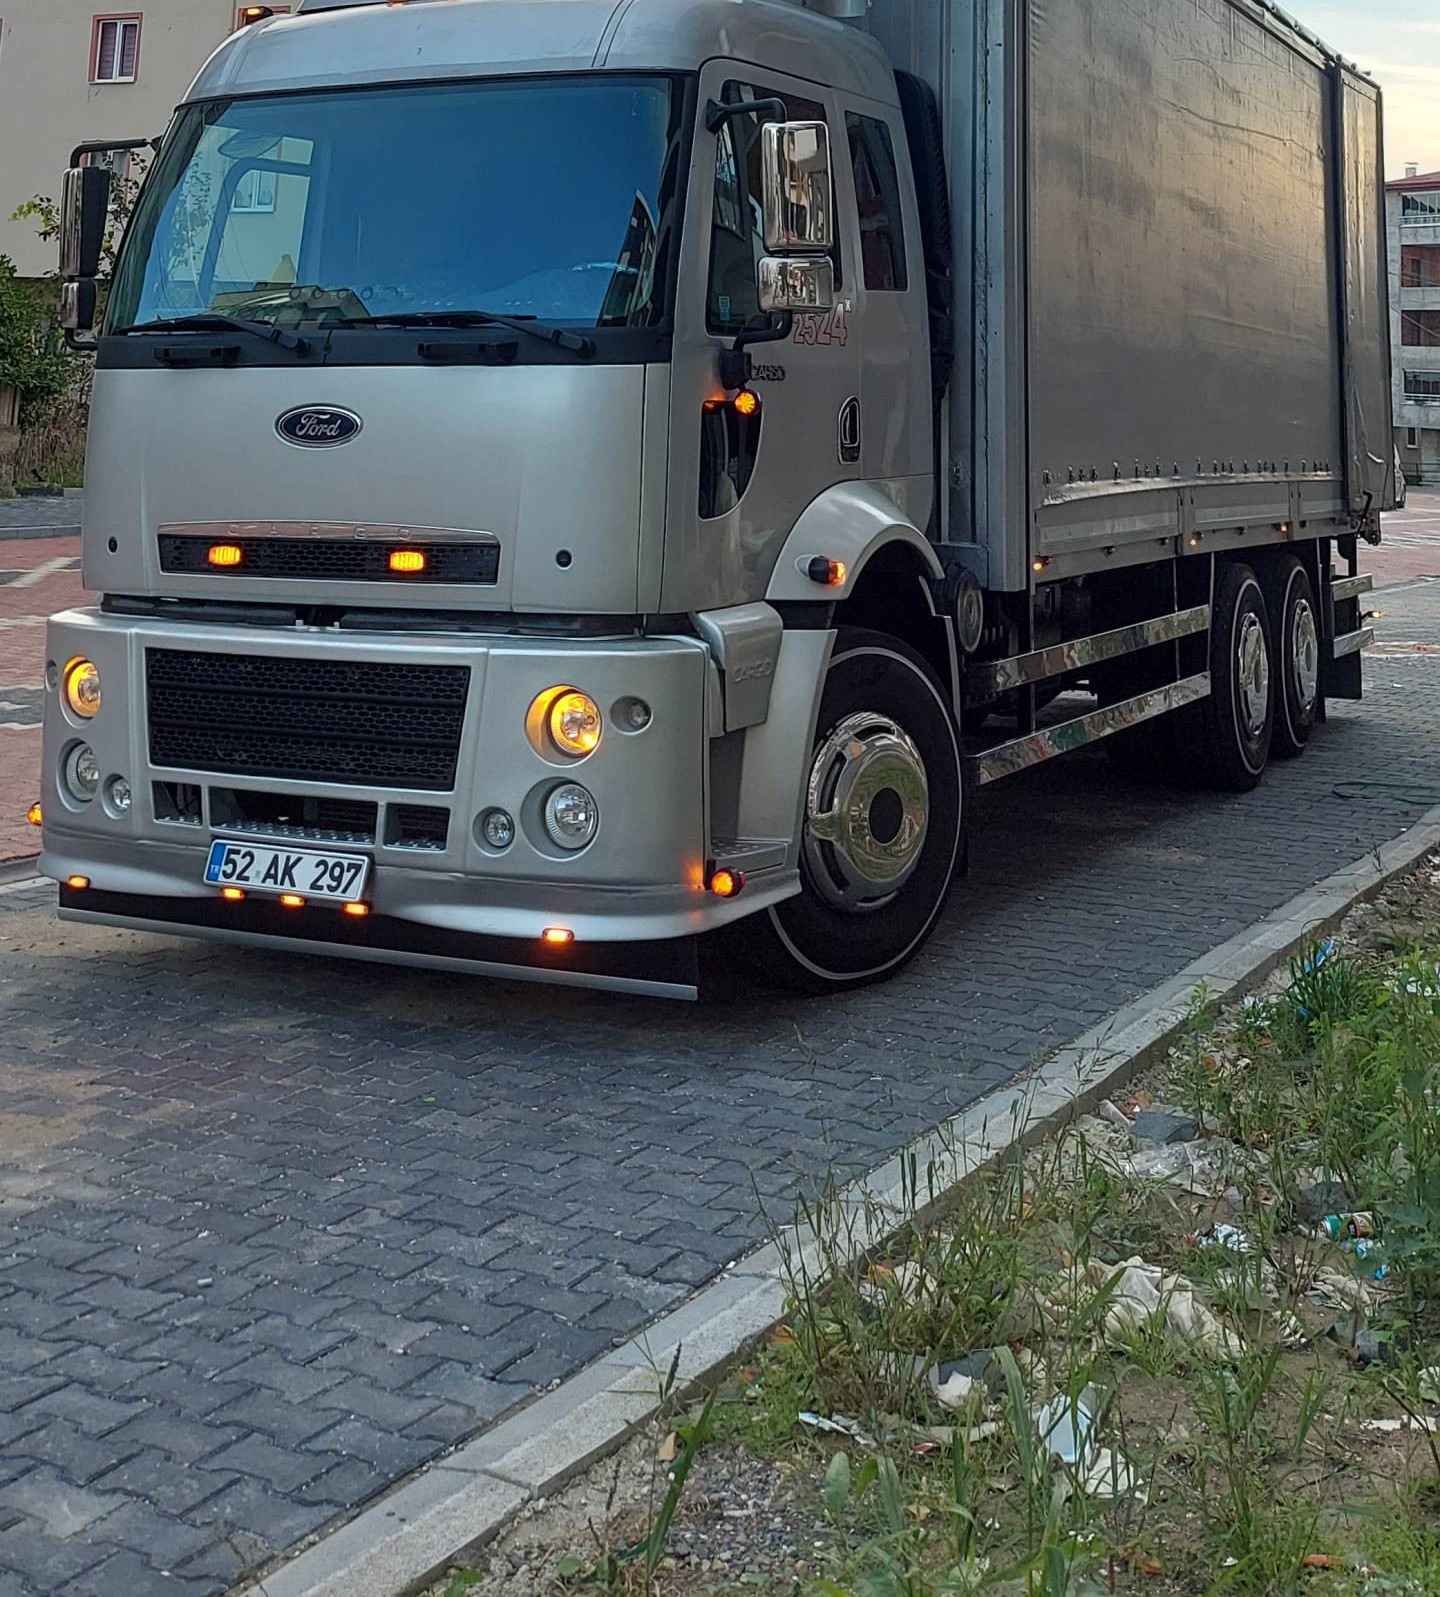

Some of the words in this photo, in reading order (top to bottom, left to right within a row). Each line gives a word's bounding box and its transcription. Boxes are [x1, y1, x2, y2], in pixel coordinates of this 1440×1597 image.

[793, 302, 847, 346] 2524
[296, 413, 342, 436] Ford
[227, 524, 412, 540] CARGO
[210, 864, 220, 875] TR
[222, 848, 255, 881] 52
[261, 854, 302, 887] AK
[309, 859, 362, 893] 297
